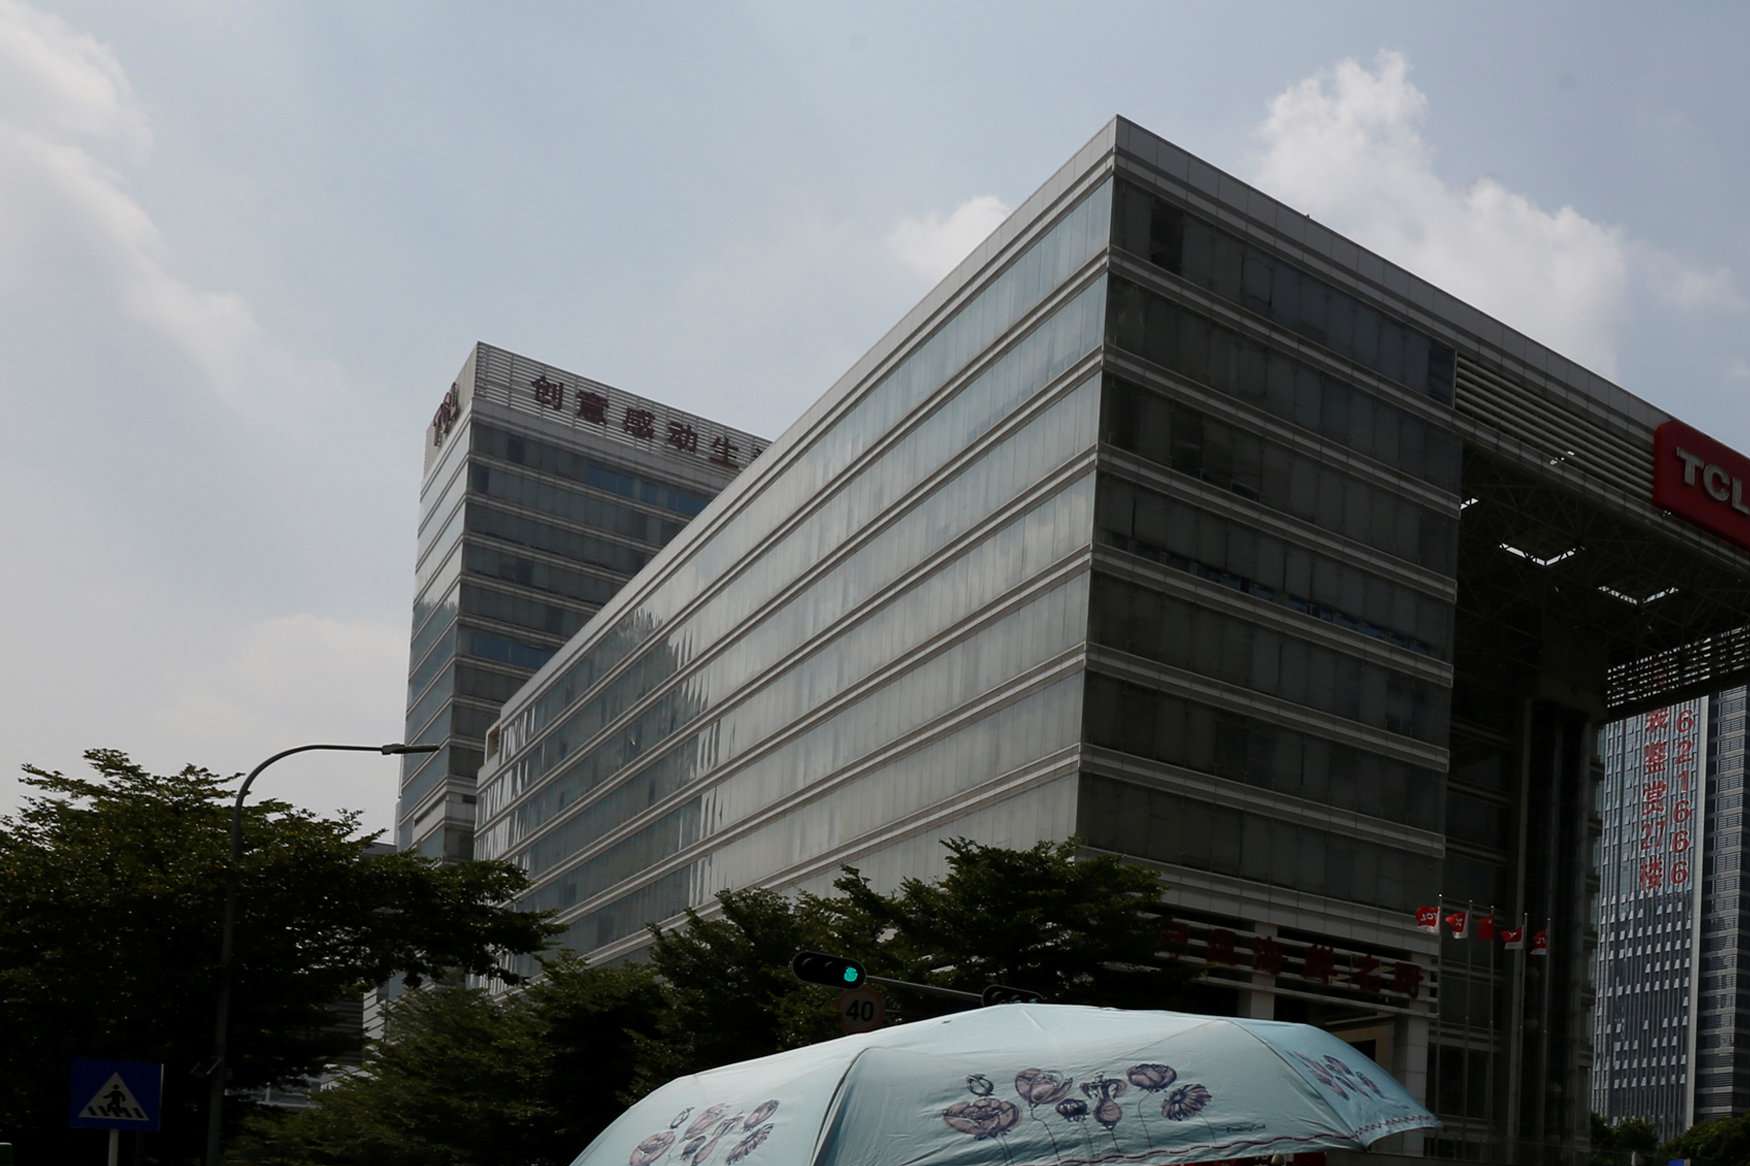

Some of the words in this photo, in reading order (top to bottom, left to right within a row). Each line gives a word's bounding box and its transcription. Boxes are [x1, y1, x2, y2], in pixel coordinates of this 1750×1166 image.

[530, 375, 766, 470] 创意感动生
[846, 1000, 874, 1022] 40
